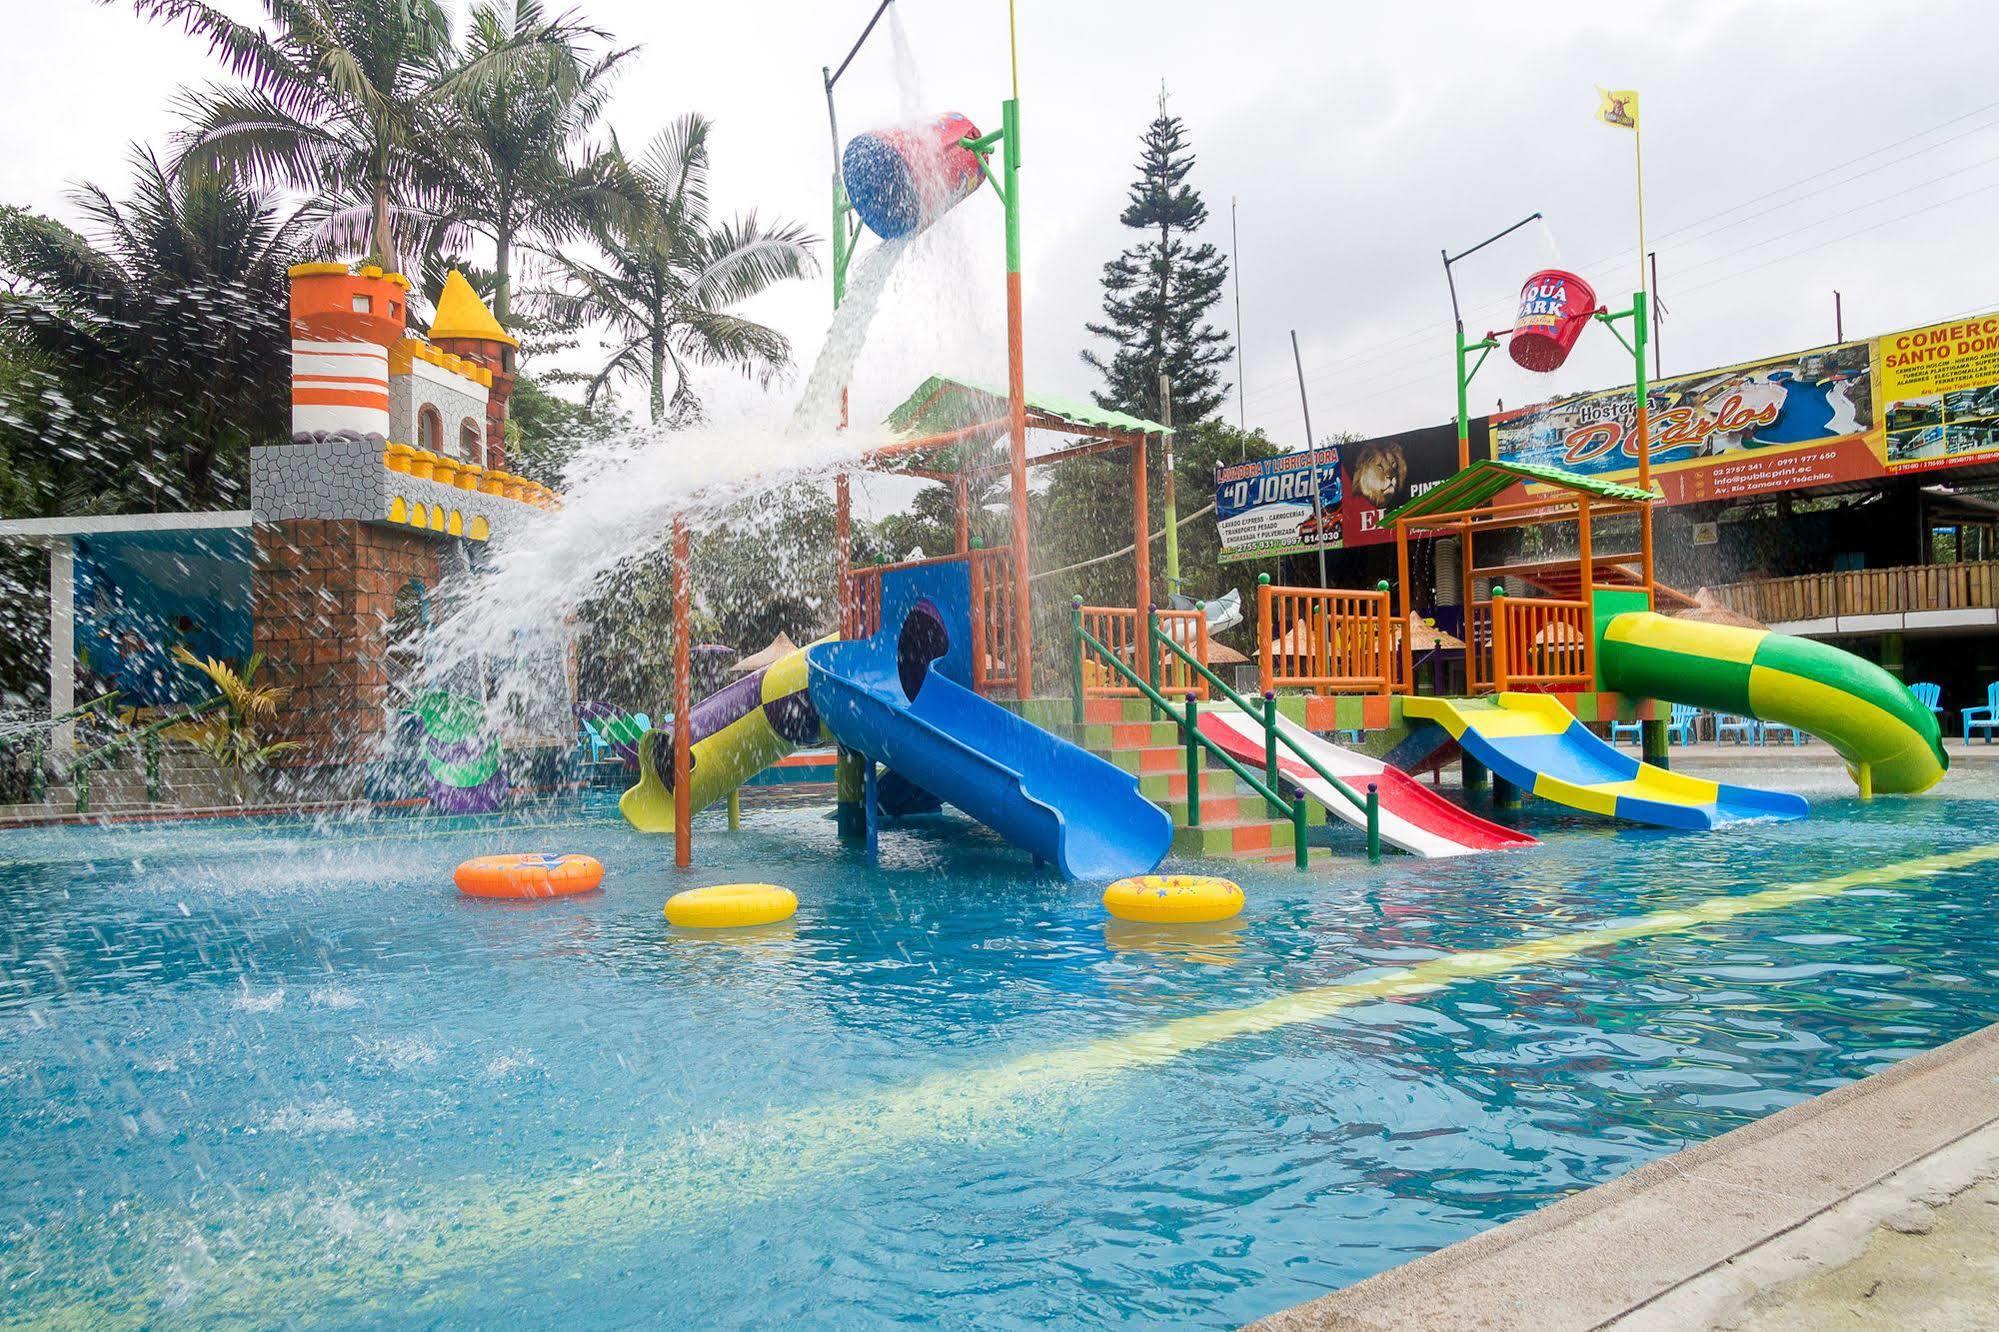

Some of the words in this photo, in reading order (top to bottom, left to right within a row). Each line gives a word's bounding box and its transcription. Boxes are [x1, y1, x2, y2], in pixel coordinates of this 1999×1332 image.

[1521, 285, 1567, 302] QUA
[1518, 299, 1563, 318] ARK
[1886, 345, 1951, 368] SANTO
[1895, 363, 1925, 375] CEMENTO
[1925, 360, 1950, 370] HOLCIM
[1954, 356, 1979, 366] HIERRO
[1897, 376, 1930, 387] ALAMBRES
[1580, 397, 1655, 422] Hostera
[1777, 457, 1798, 467] 0991
[1800, 454, 1818, 463] 977
[1217, 463, 1263, 483] LAVADORA
[1264, 460, 1271, 478] Y
[1714, 486, 1728, 495] Av.
[1747, 479, 1782, 491] Zamora
[1221, 520, 1241, 529] LAVADO
[1241, 516, 1264, 526] EXPRESS
[1225, 524, 1257, 536] TRANSPORTE
[1257, 522, 1278, 531] PESADO
[1261, 528, 1296, 538] PULVERIZADA
[1322, 531, 1340, 541] 030
